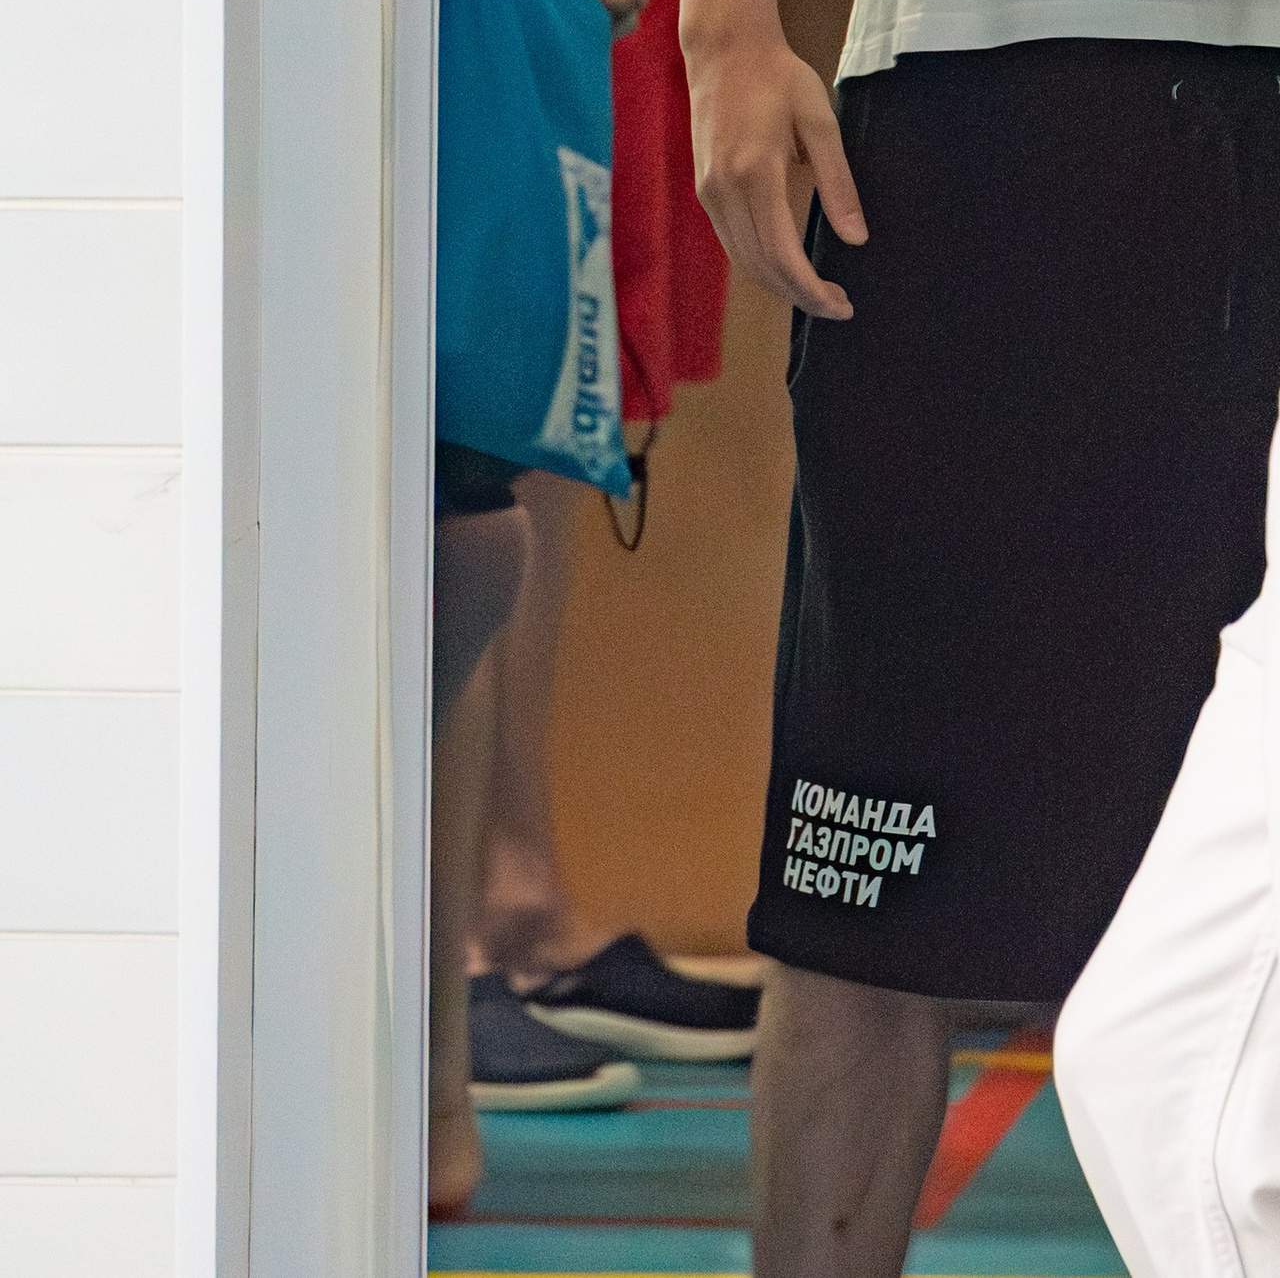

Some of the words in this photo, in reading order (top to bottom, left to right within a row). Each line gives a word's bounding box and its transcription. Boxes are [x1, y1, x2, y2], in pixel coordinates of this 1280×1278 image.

[791, 779, 937, 838] КОМАНДА
[786, 817, 926, 875] ГАЗПРОМ
[783, 855, 883, 908] НЕФТИ
